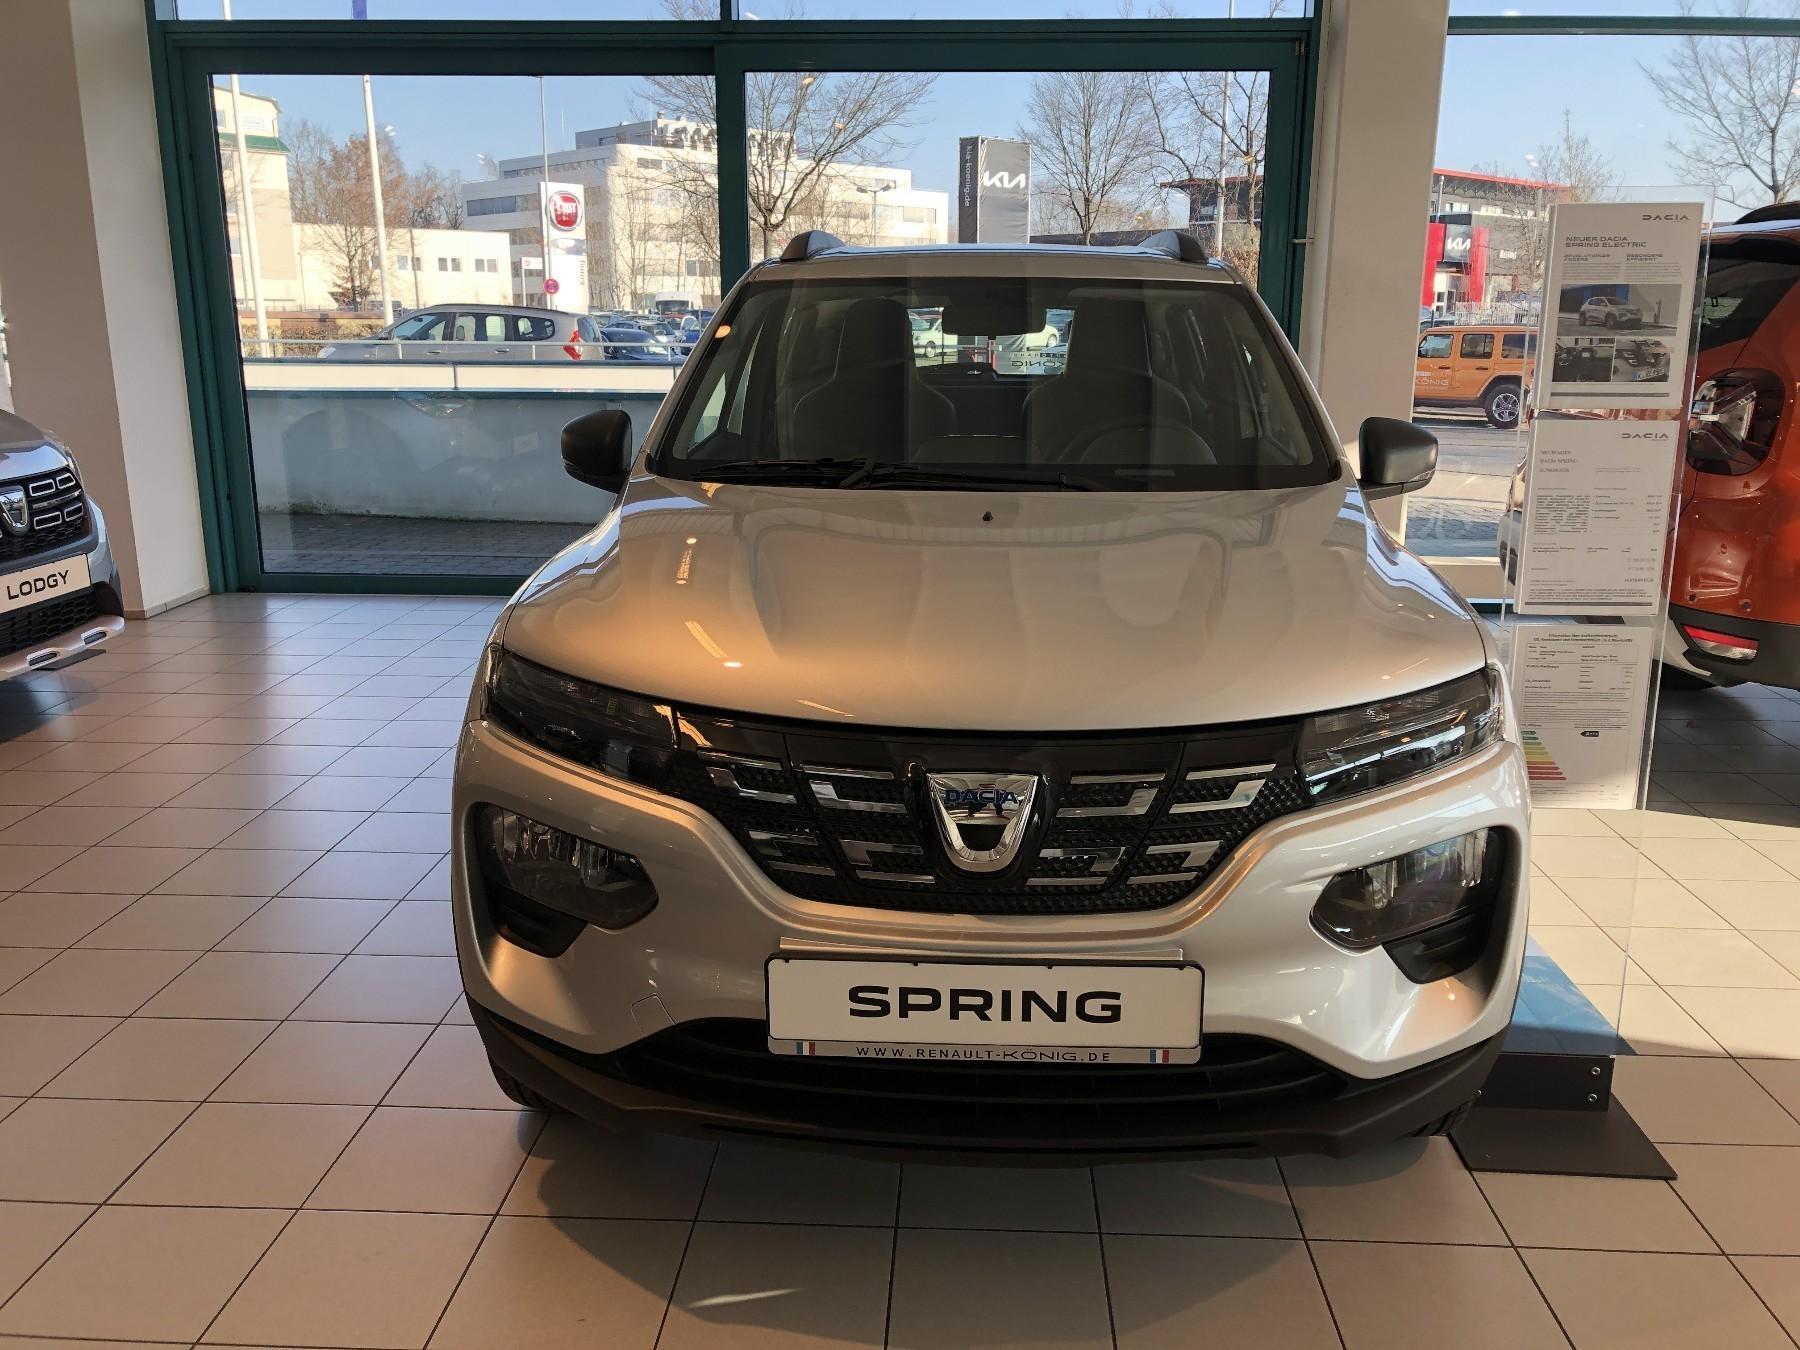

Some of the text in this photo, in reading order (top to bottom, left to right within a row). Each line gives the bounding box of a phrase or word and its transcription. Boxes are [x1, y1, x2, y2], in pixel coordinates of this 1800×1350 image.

[6, 570, 68, 600] LODGY
[944, 788, 1019, 804] DACIA
[848, 986, 1122, 1024] SPRING
[856, 1046, 1111, 1062] WWW.RENAULT-KÖNIG.DE
